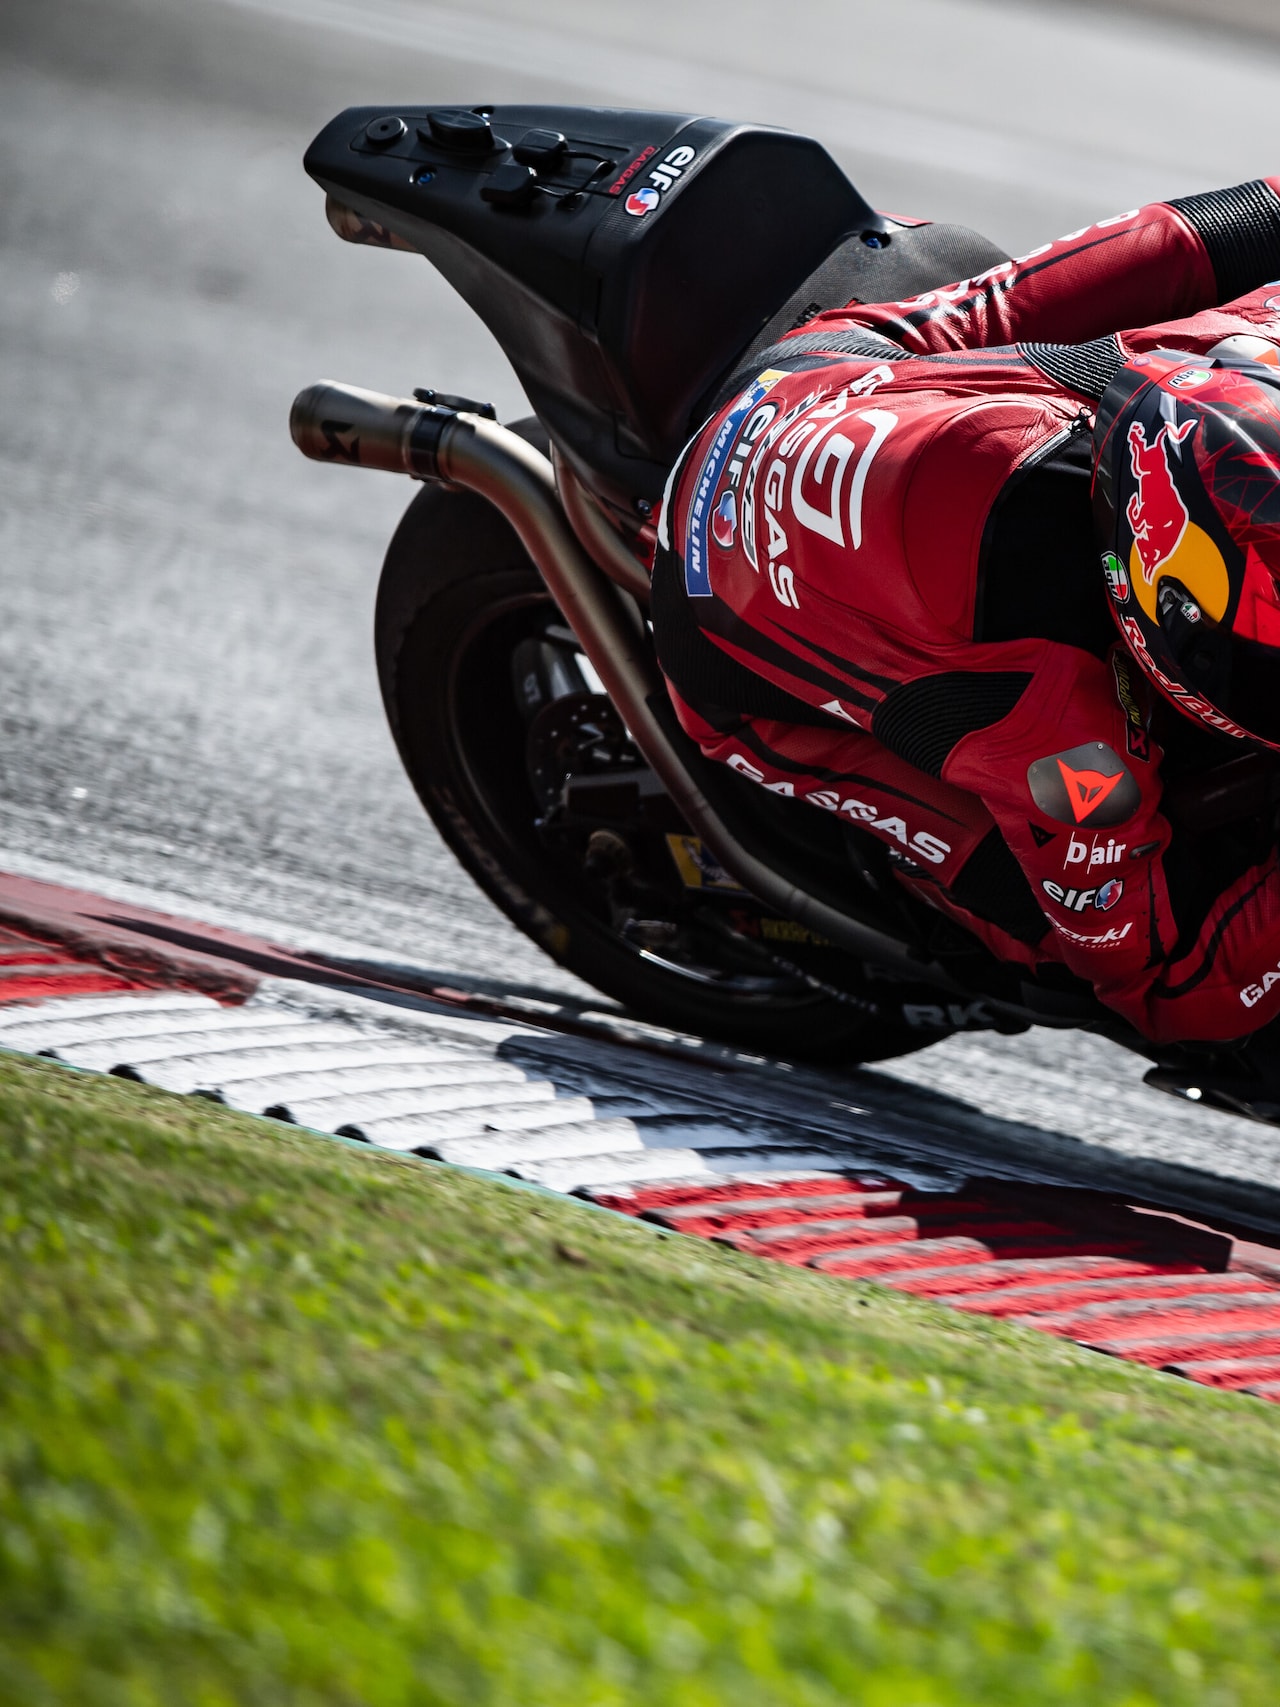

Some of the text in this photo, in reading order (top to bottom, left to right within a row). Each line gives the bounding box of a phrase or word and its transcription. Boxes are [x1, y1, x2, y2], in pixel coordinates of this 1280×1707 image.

[648, 145, 696, 192] elf
[724, 402, 778, 488] elf
[690, 420, 734, 574] MICHELIN
[1121, 614, 1189, 694] Red
[1043, 880, 1096, 911] elf
